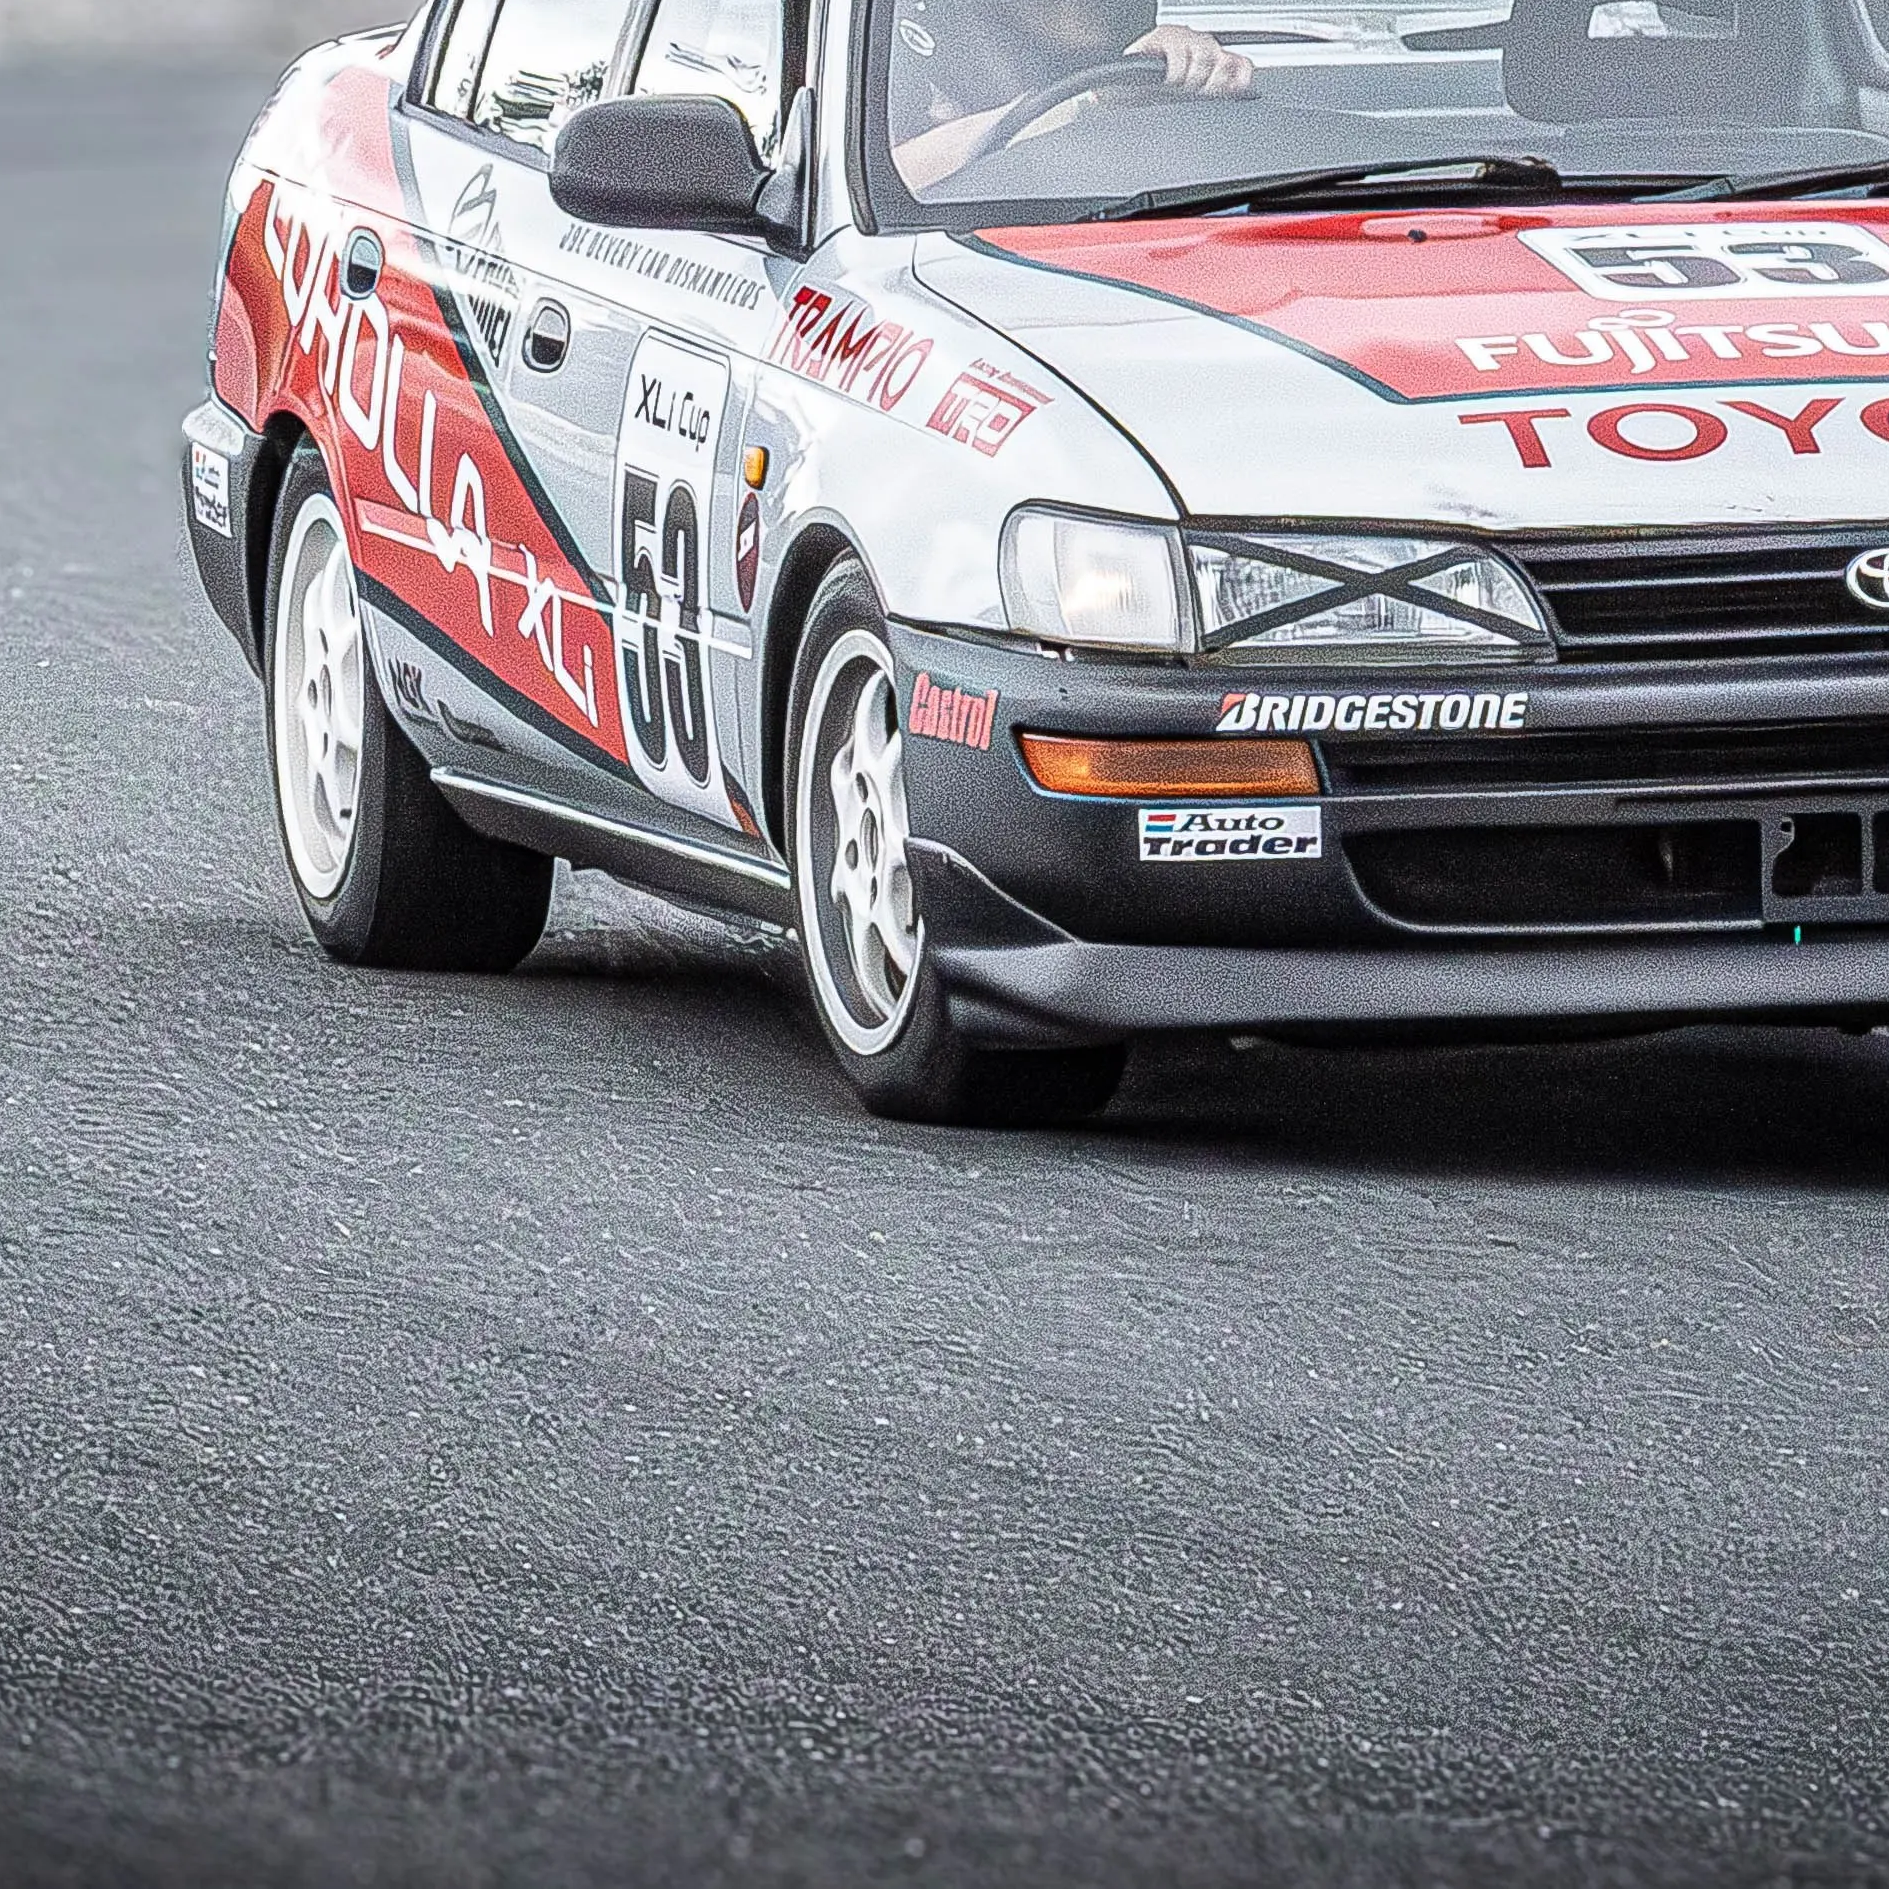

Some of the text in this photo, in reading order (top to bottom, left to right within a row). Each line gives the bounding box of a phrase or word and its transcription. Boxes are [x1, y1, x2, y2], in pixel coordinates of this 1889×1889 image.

[678, 391, 710, 452] Cup
[621, 474, 710, 788] 53
[908, 670, 999, 751] Castrol
[1216, 693, 1528, 732] BRIDGESTONE
[1143, 834, 1318, 856] Trader
[1174, 813, 1284, 832] Auto
